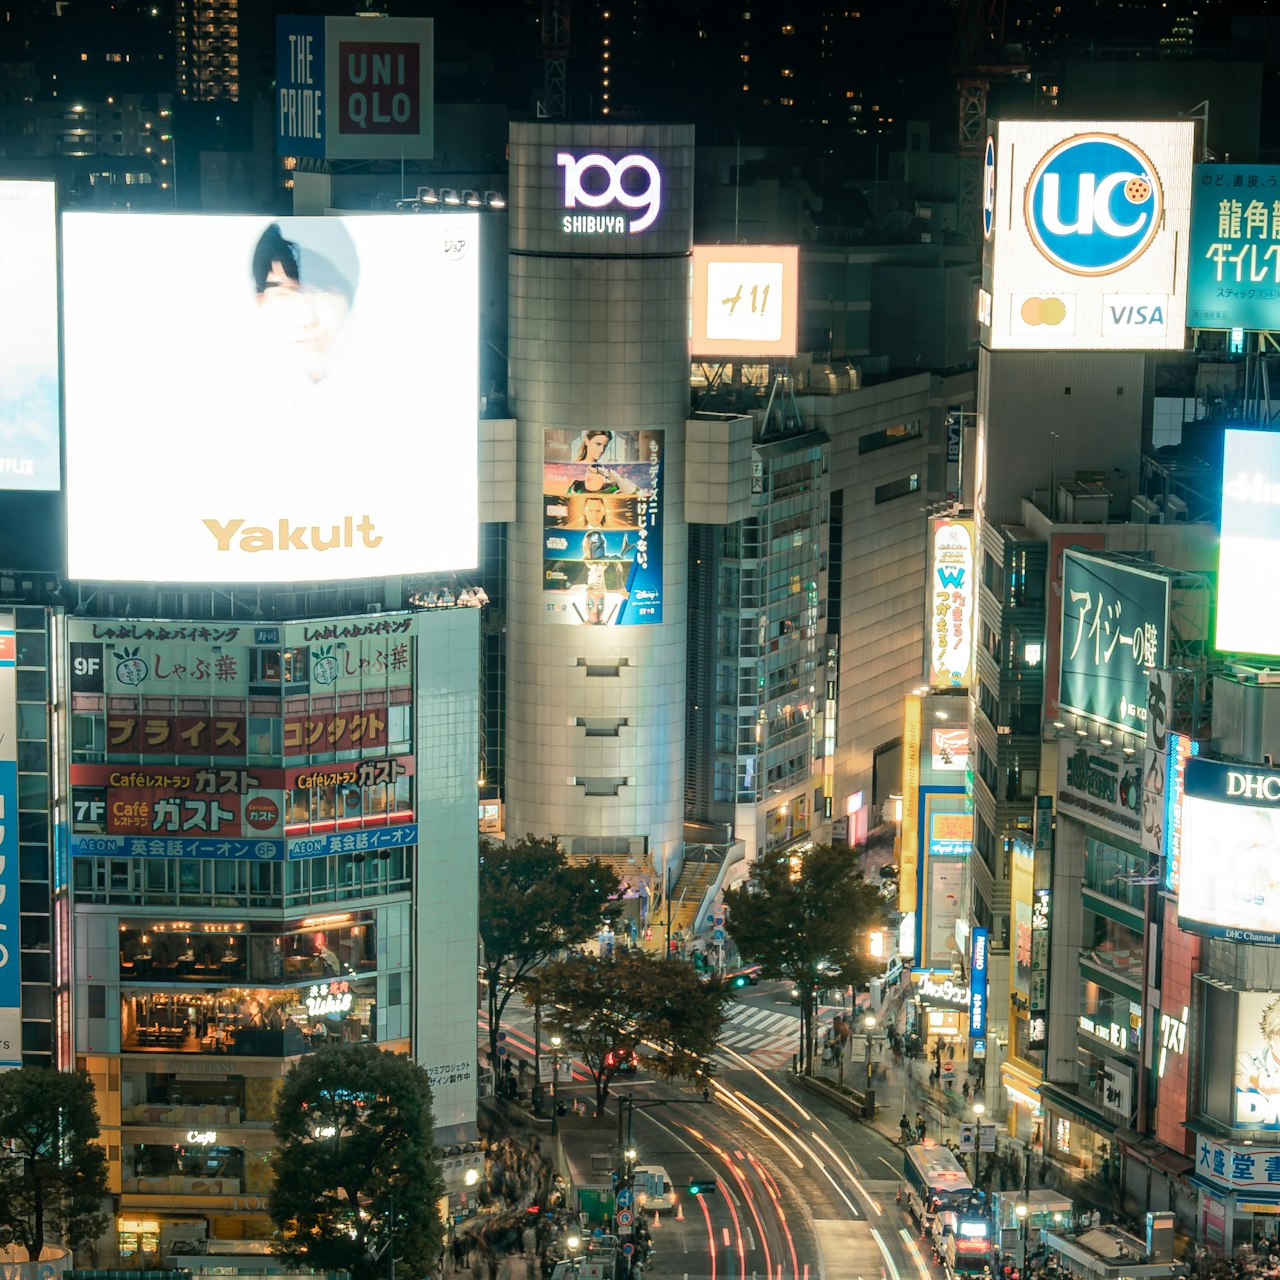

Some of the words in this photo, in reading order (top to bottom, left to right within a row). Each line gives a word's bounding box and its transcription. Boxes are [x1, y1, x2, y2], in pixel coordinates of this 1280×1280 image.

[288, 35, 314, 84] THE
[348, 53, 406, 85] UNI
[280, 88, 322, 139] PRIME
[348, 92, 411, 129] QLO
[557, 153, 661, 233] 109
[563, 215, 625, 233] SHIBUYA
[1216, 288, 1256, 300] スティック
[1110, 305, 1164, 325] VISA
[948, 429, 959, 463] LABI
[649, 440, 659, 526] もうディズニー
[202, 515, 384, 553] Yakult
[92, 624, 241, 643] しゃぶしゃぶバイキング
[303, 618, 414, 641] しゃぶしゃぶバイキング
[1069, 589, 1157, 668] アイジーの壁
[74, 658, 100, 676] 9F
[154, 654, 239, 683] しゃぶ葉
[344, 643, 409, 677] しゃぶ葉
[108, 718, 243, 748] プライス
[284, 712, 386, 747] コンタクト
[195, 768, 260, 796] ガスト
[357, 759, 407, 787] ガスト
[74, 801, 105, 822] 7F
[113, 801, 149, 818] Café
[113, 814, 149, 827] レストラン
[152, 798, 237, 832] ガスト
[248, 810, 277, 822] ガスト
[78, 838, 118, 853] AEON
[131, 839, 250, 858] 英会話イーオン
[257, 844, 275, 857] 6F
[292, 839, 322, 857] AEON
[329, 828, 417, 852] 英会話イーオン
[1226, 929, 1243, 941] DHC
[1243, 930, 1276, 942] Channel
[186, 1130, 217, 1147] Café
